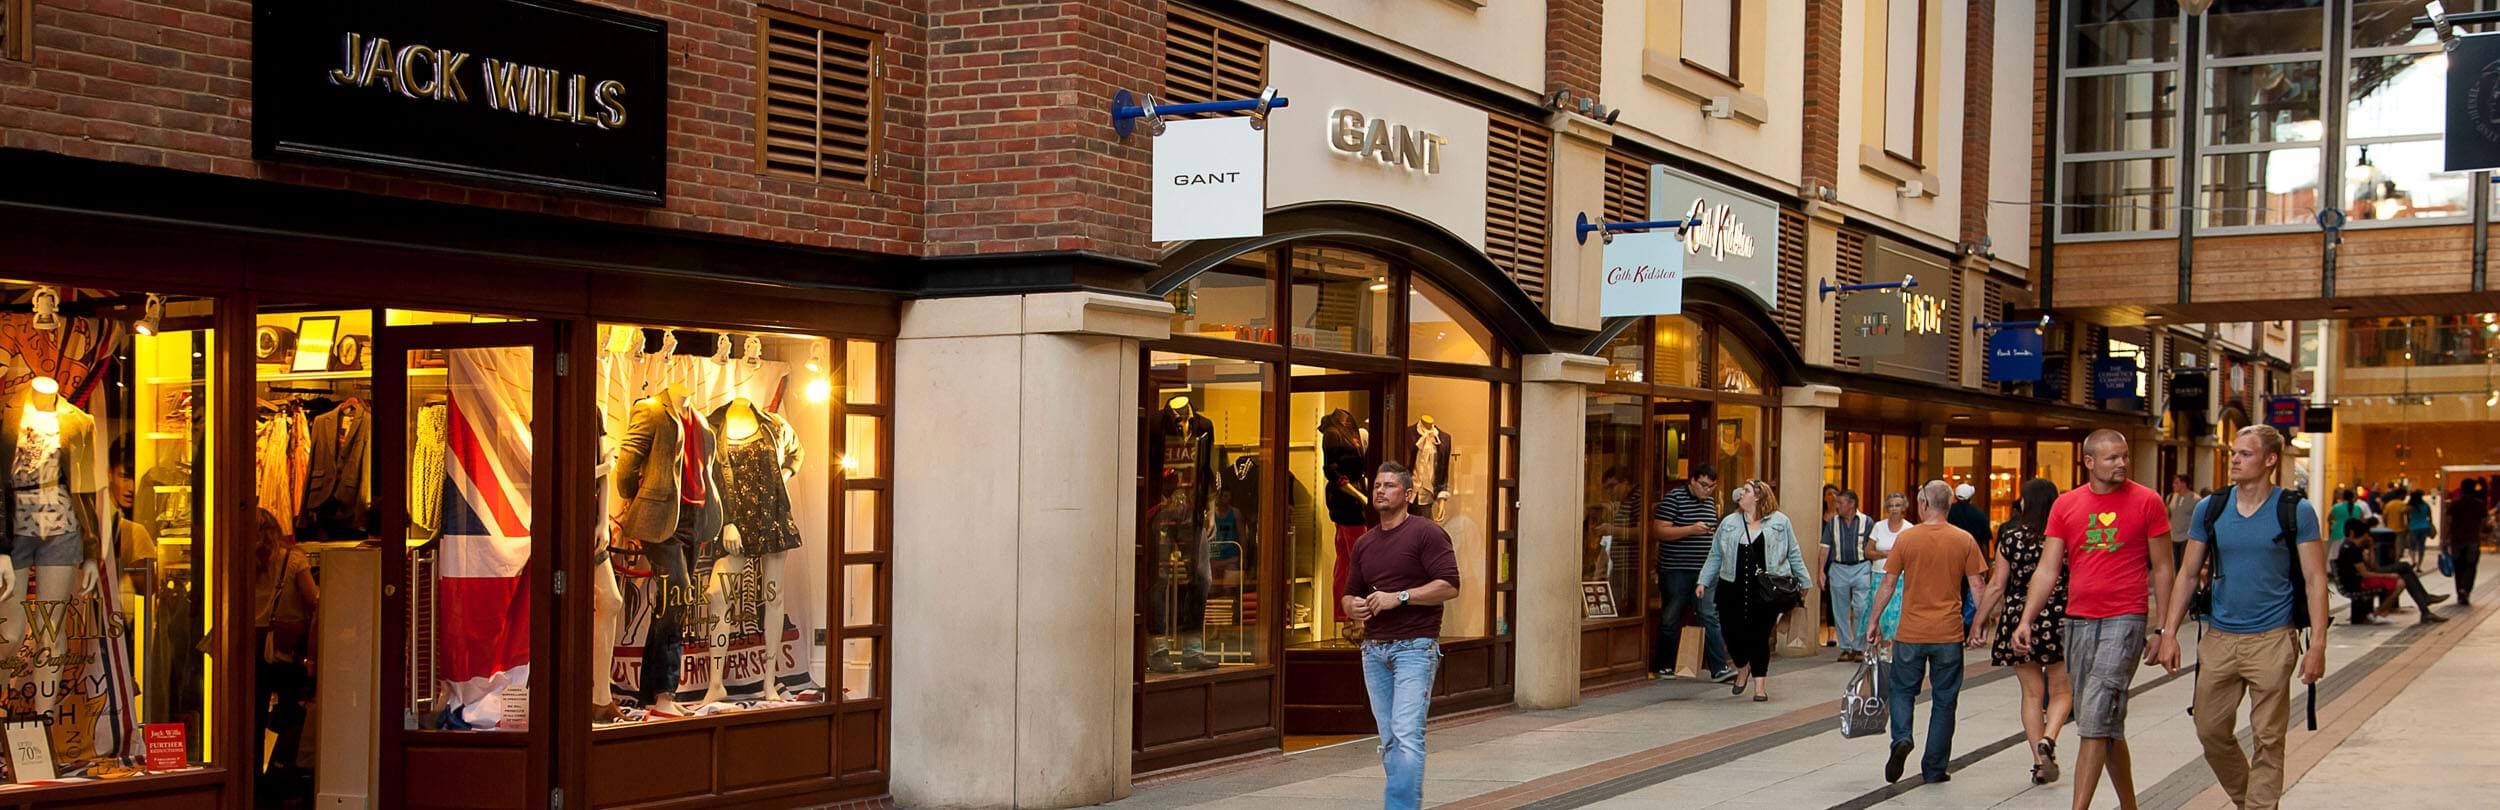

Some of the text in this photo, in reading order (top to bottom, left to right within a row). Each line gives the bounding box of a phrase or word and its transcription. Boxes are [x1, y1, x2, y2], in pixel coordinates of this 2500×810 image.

[329, 31, 627, 129] JACK WILLS
[1331, 108, 1449, 175] GANT
[1174, 172, 1240, 186] GANT
[1686, 197, 1713, 255] Cath
[1608, 265, 1676, 285] Cath Kidston
[2088, 513, 2097, 528] I
[656, 572, 711, 619] Jack
[717, 570, 777, 604] Wills
[20, 596, 124, 643] Wills
[685, 652, 748, 672] BRTISH
[0, 673, 107, 700] LOUSLY
